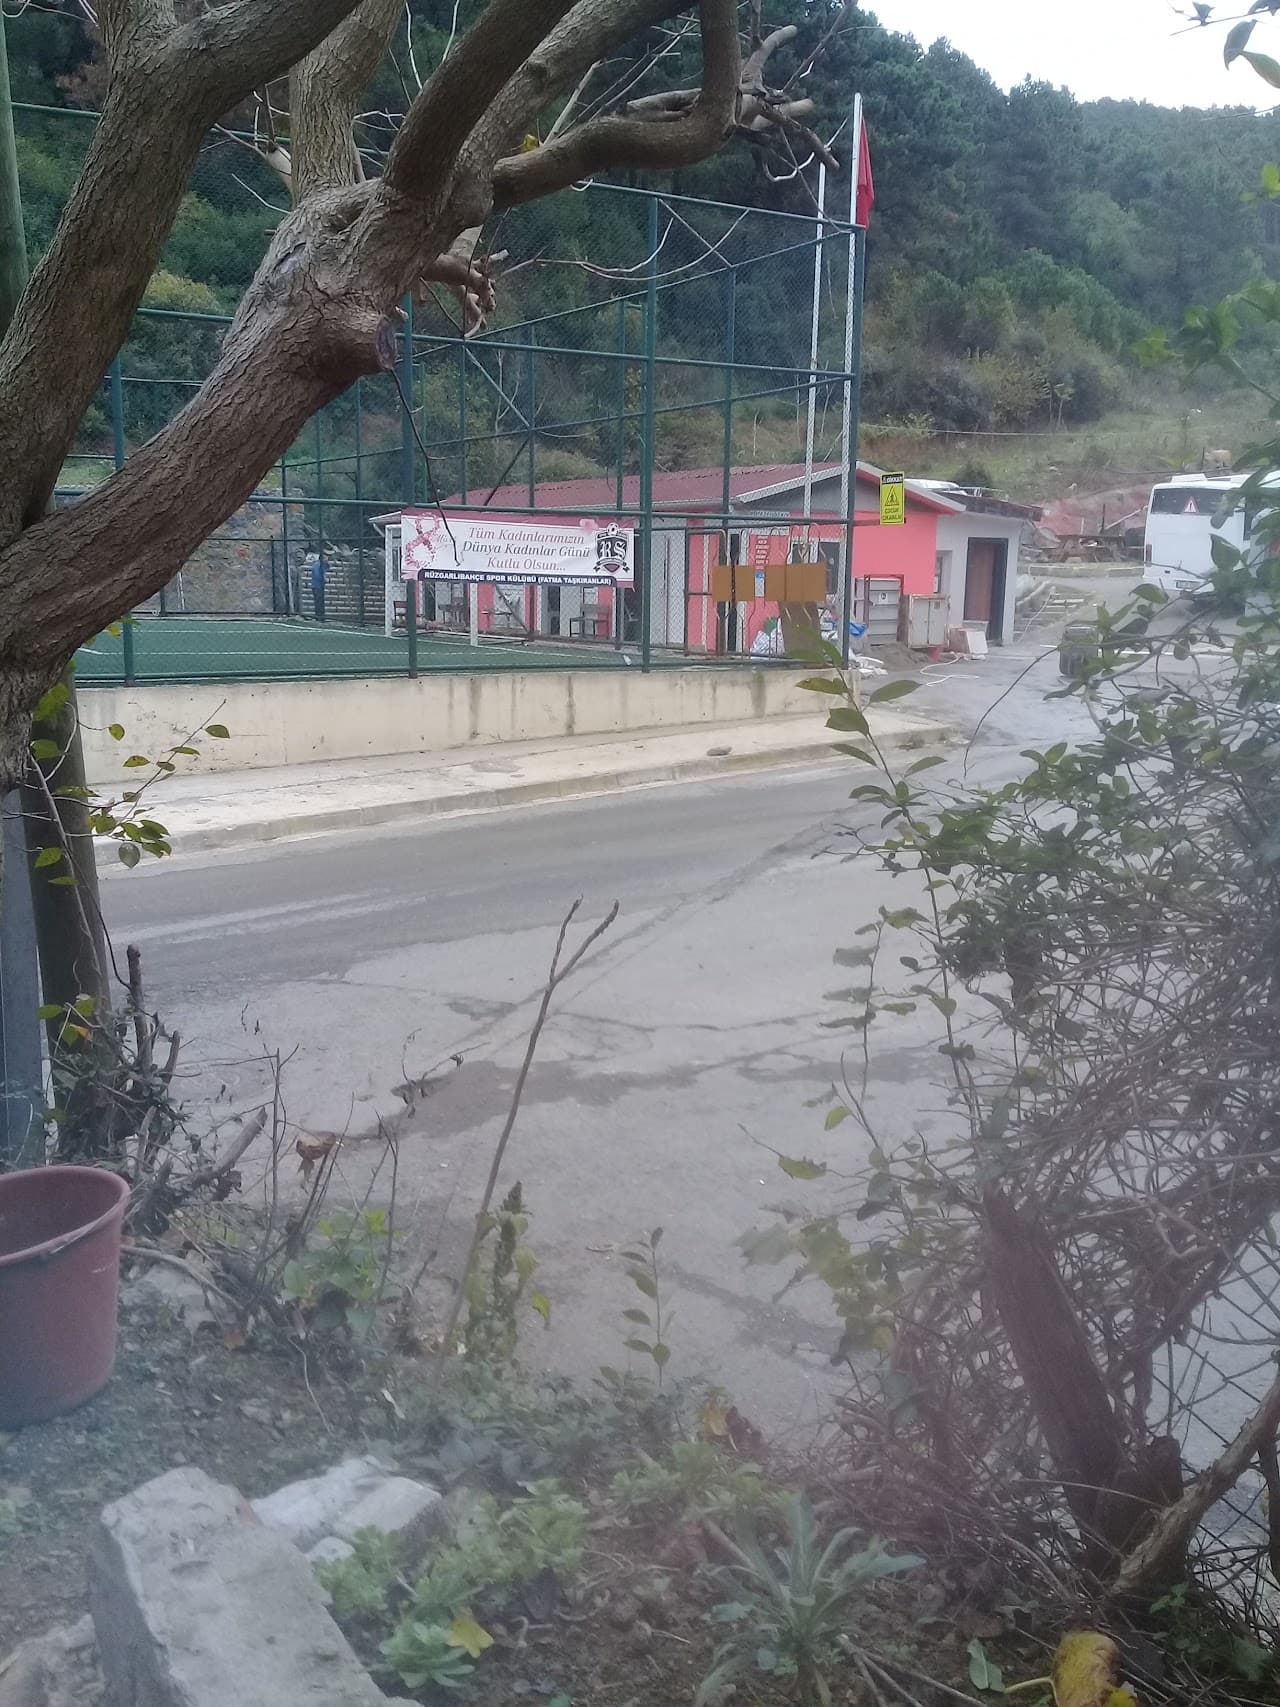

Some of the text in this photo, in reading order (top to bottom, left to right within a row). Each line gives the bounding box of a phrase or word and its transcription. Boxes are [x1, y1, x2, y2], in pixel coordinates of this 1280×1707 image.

[469, 527, 495, 540] Tüm
[498, 528, 585, 545] Kadınlarımızın
[463, 540, 591, 558] Dünya Kadınlar Günü
[487, 557, 566, 571] Kutlu Olsun...
[486, 574, 506, 582] SPOR
